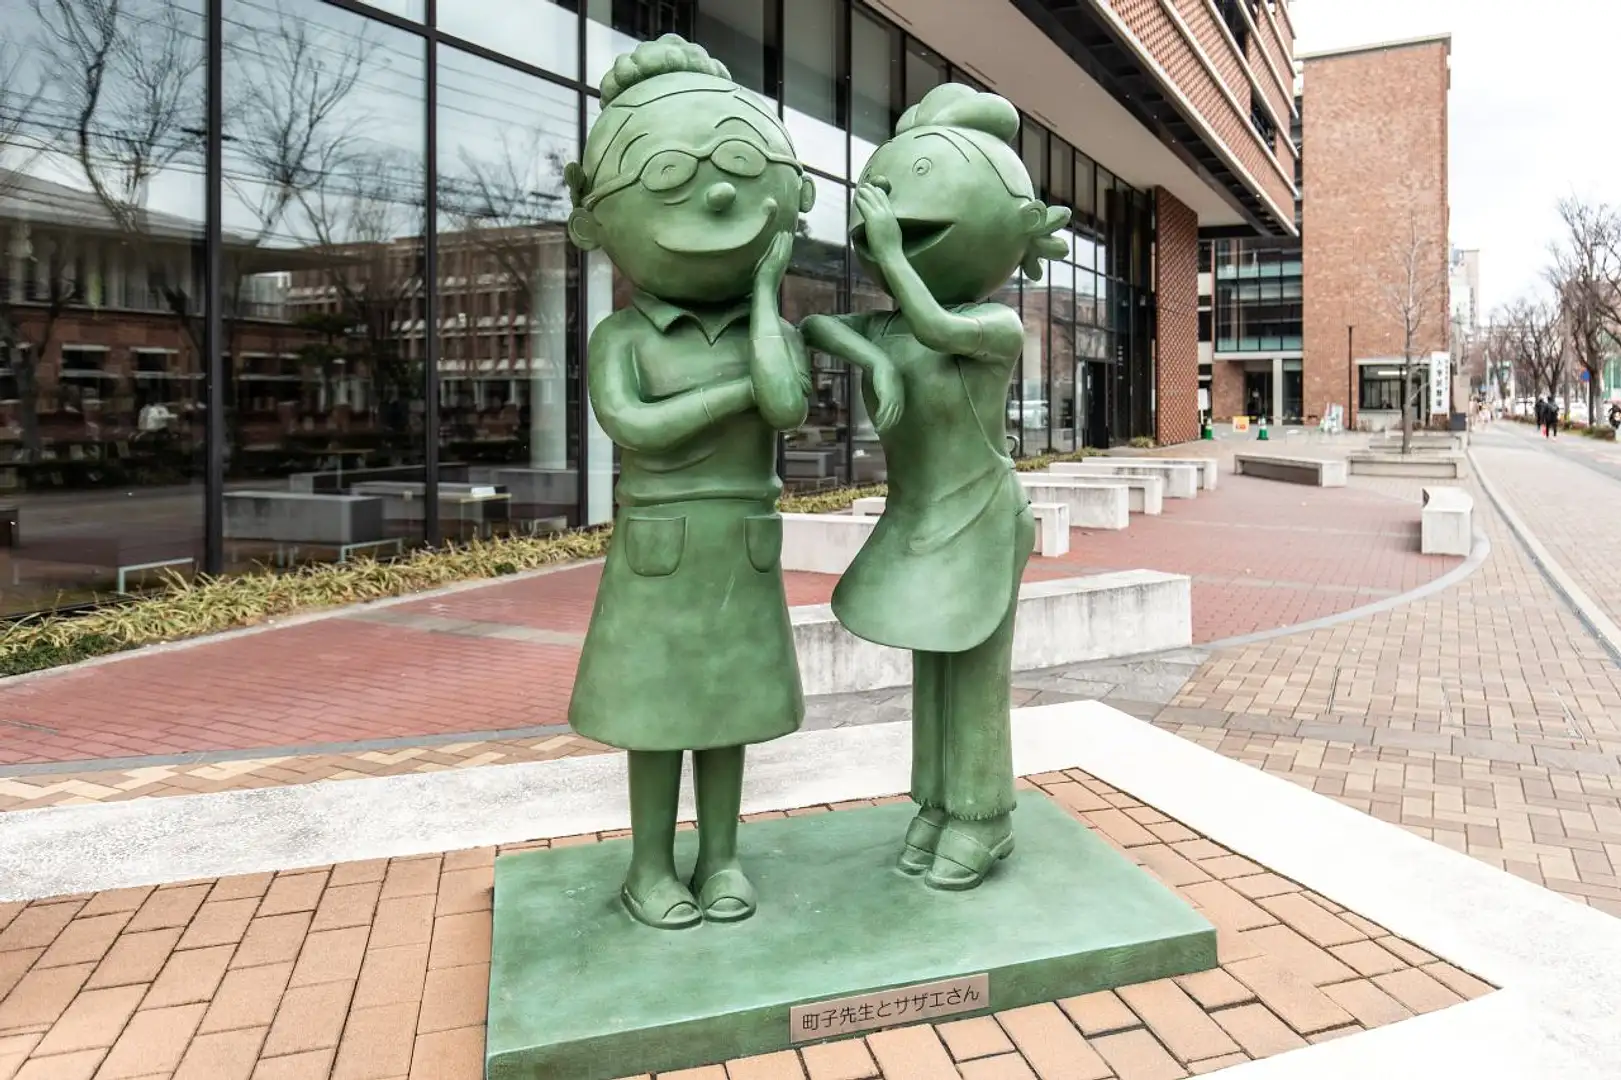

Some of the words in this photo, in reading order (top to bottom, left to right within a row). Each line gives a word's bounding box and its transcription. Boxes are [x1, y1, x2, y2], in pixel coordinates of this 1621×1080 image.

[802, 985, 980, 1031] 町子先生とサザエさん
